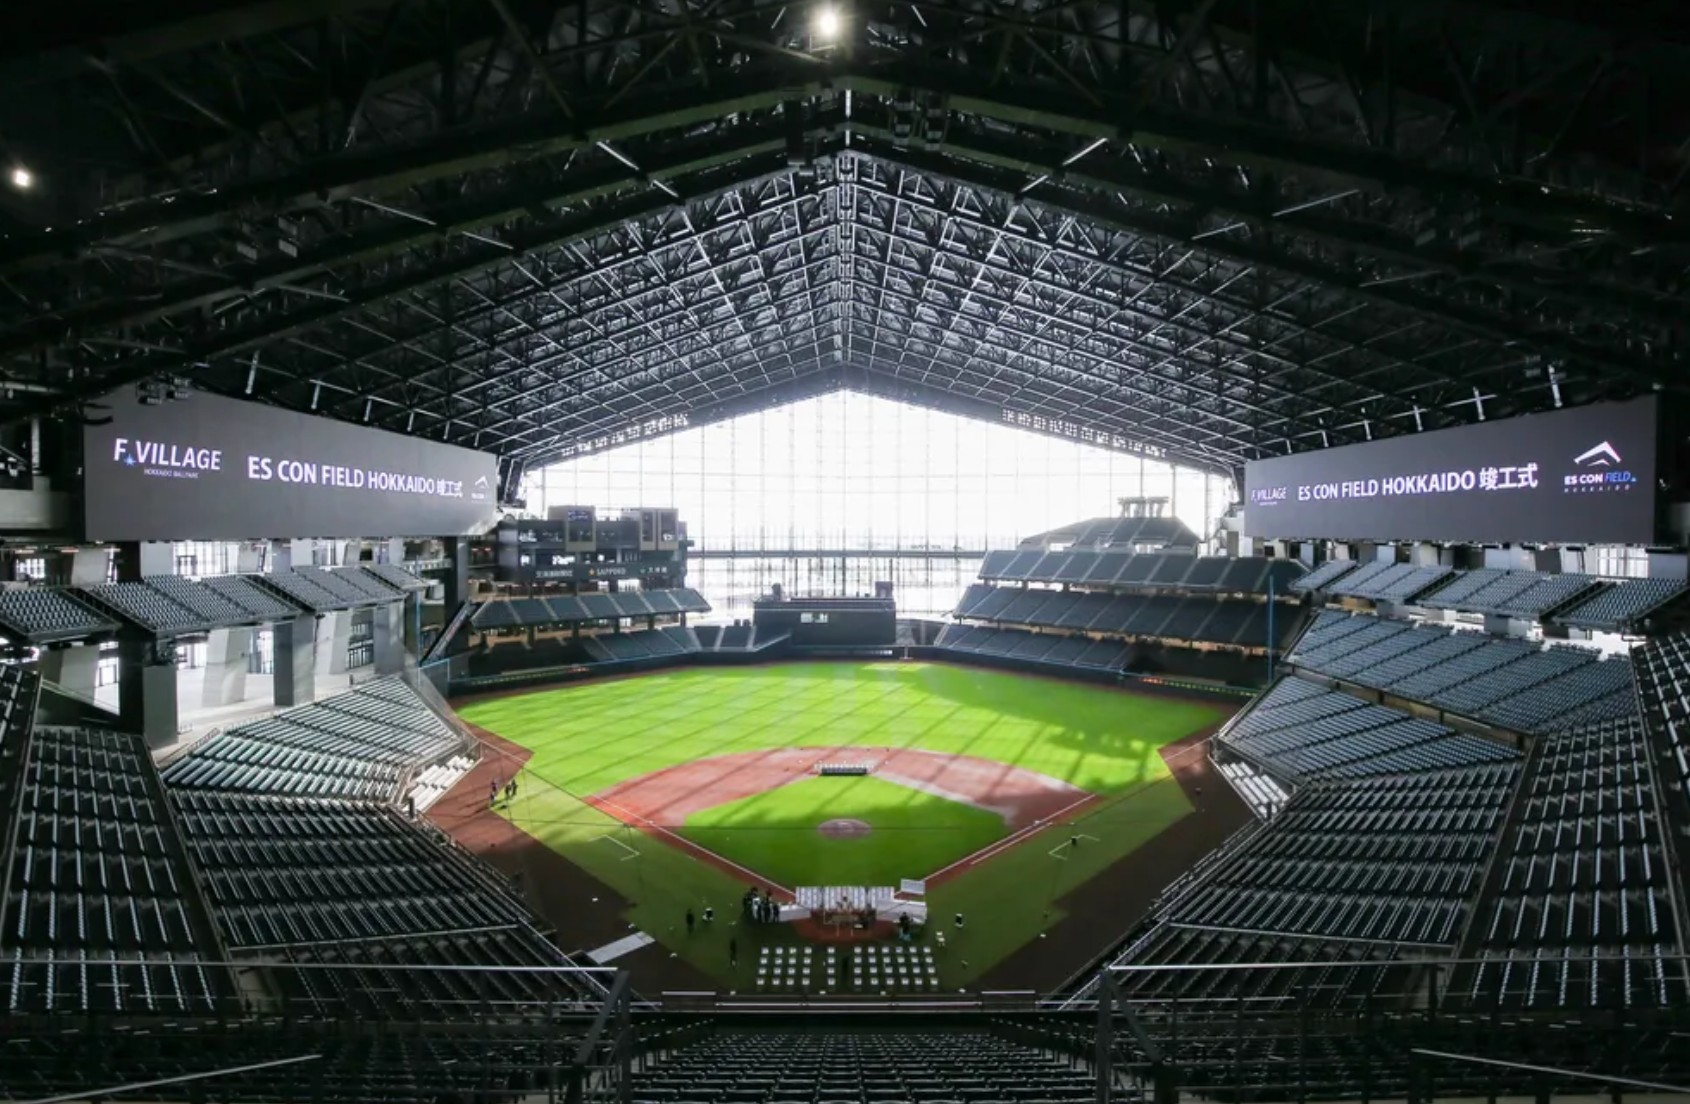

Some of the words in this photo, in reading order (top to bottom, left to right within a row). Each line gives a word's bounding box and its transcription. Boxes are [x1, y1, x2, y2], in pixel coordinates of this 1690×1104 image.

[135, 440, 222, 470] VILLAGE
[248, 456, 272, 480] ES
[278, 460, 316, 484] CON
[321, 465, 364, 488] FIELD
[368, 471, 435, 494] HOKKAIDO
[1299, 486, 1311, 500] ES
[1313, 483, 1338, 499] CON
[1342, 479, 1379, 497] FIELD
[1382, 470, 1476, 496] HOKKAIDO
[1479, 462, 1538, 490] 竣工式
[1564, 475, 1577, 485] ES
[1580, 473, 1603, 484] CON
[1605, 471, 1631, 483] FIELD
